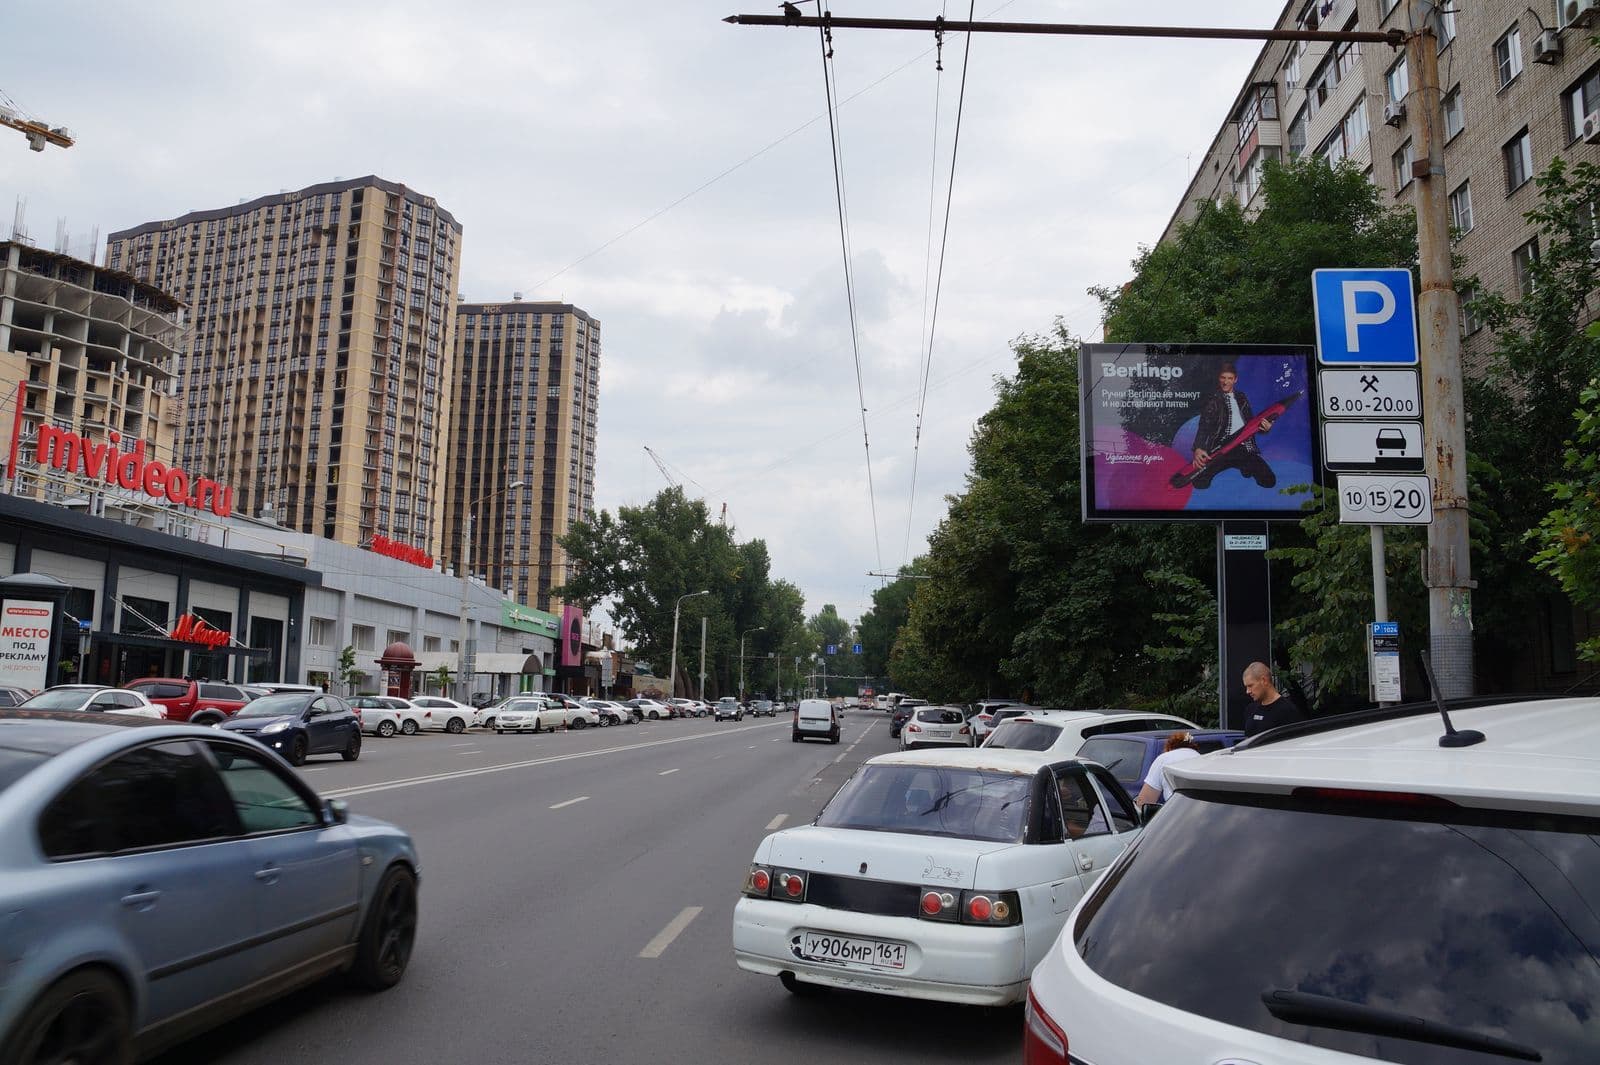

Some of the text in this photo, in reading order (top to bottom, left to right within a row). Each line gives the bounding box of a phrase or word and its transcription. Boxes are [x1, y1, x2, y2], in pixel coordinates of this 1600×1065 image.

[1342, 280, 1396, 353] P
[1101, 362, 1183, 381] Berlingo
[1102, 388, 1126, 400] Ручки
[1128, 388, 1161, 400] Berlingo
[1175, 391, 1201, 400] мажут
[1121, 400, 1164, 408] оставляют
[1166, 400, 1189, 408] пятен
[36, 423, 233, 518] mvideo.ru
[1346, 489, 1422, 509] 10 15 20
[1, 626, 50, 639] МЕСТО
[12, 641, 36, 651] ПОД
[0, 652, 47, 662] РЕКЛАМУ
[811, 938, 901, 960] У906МР 161
